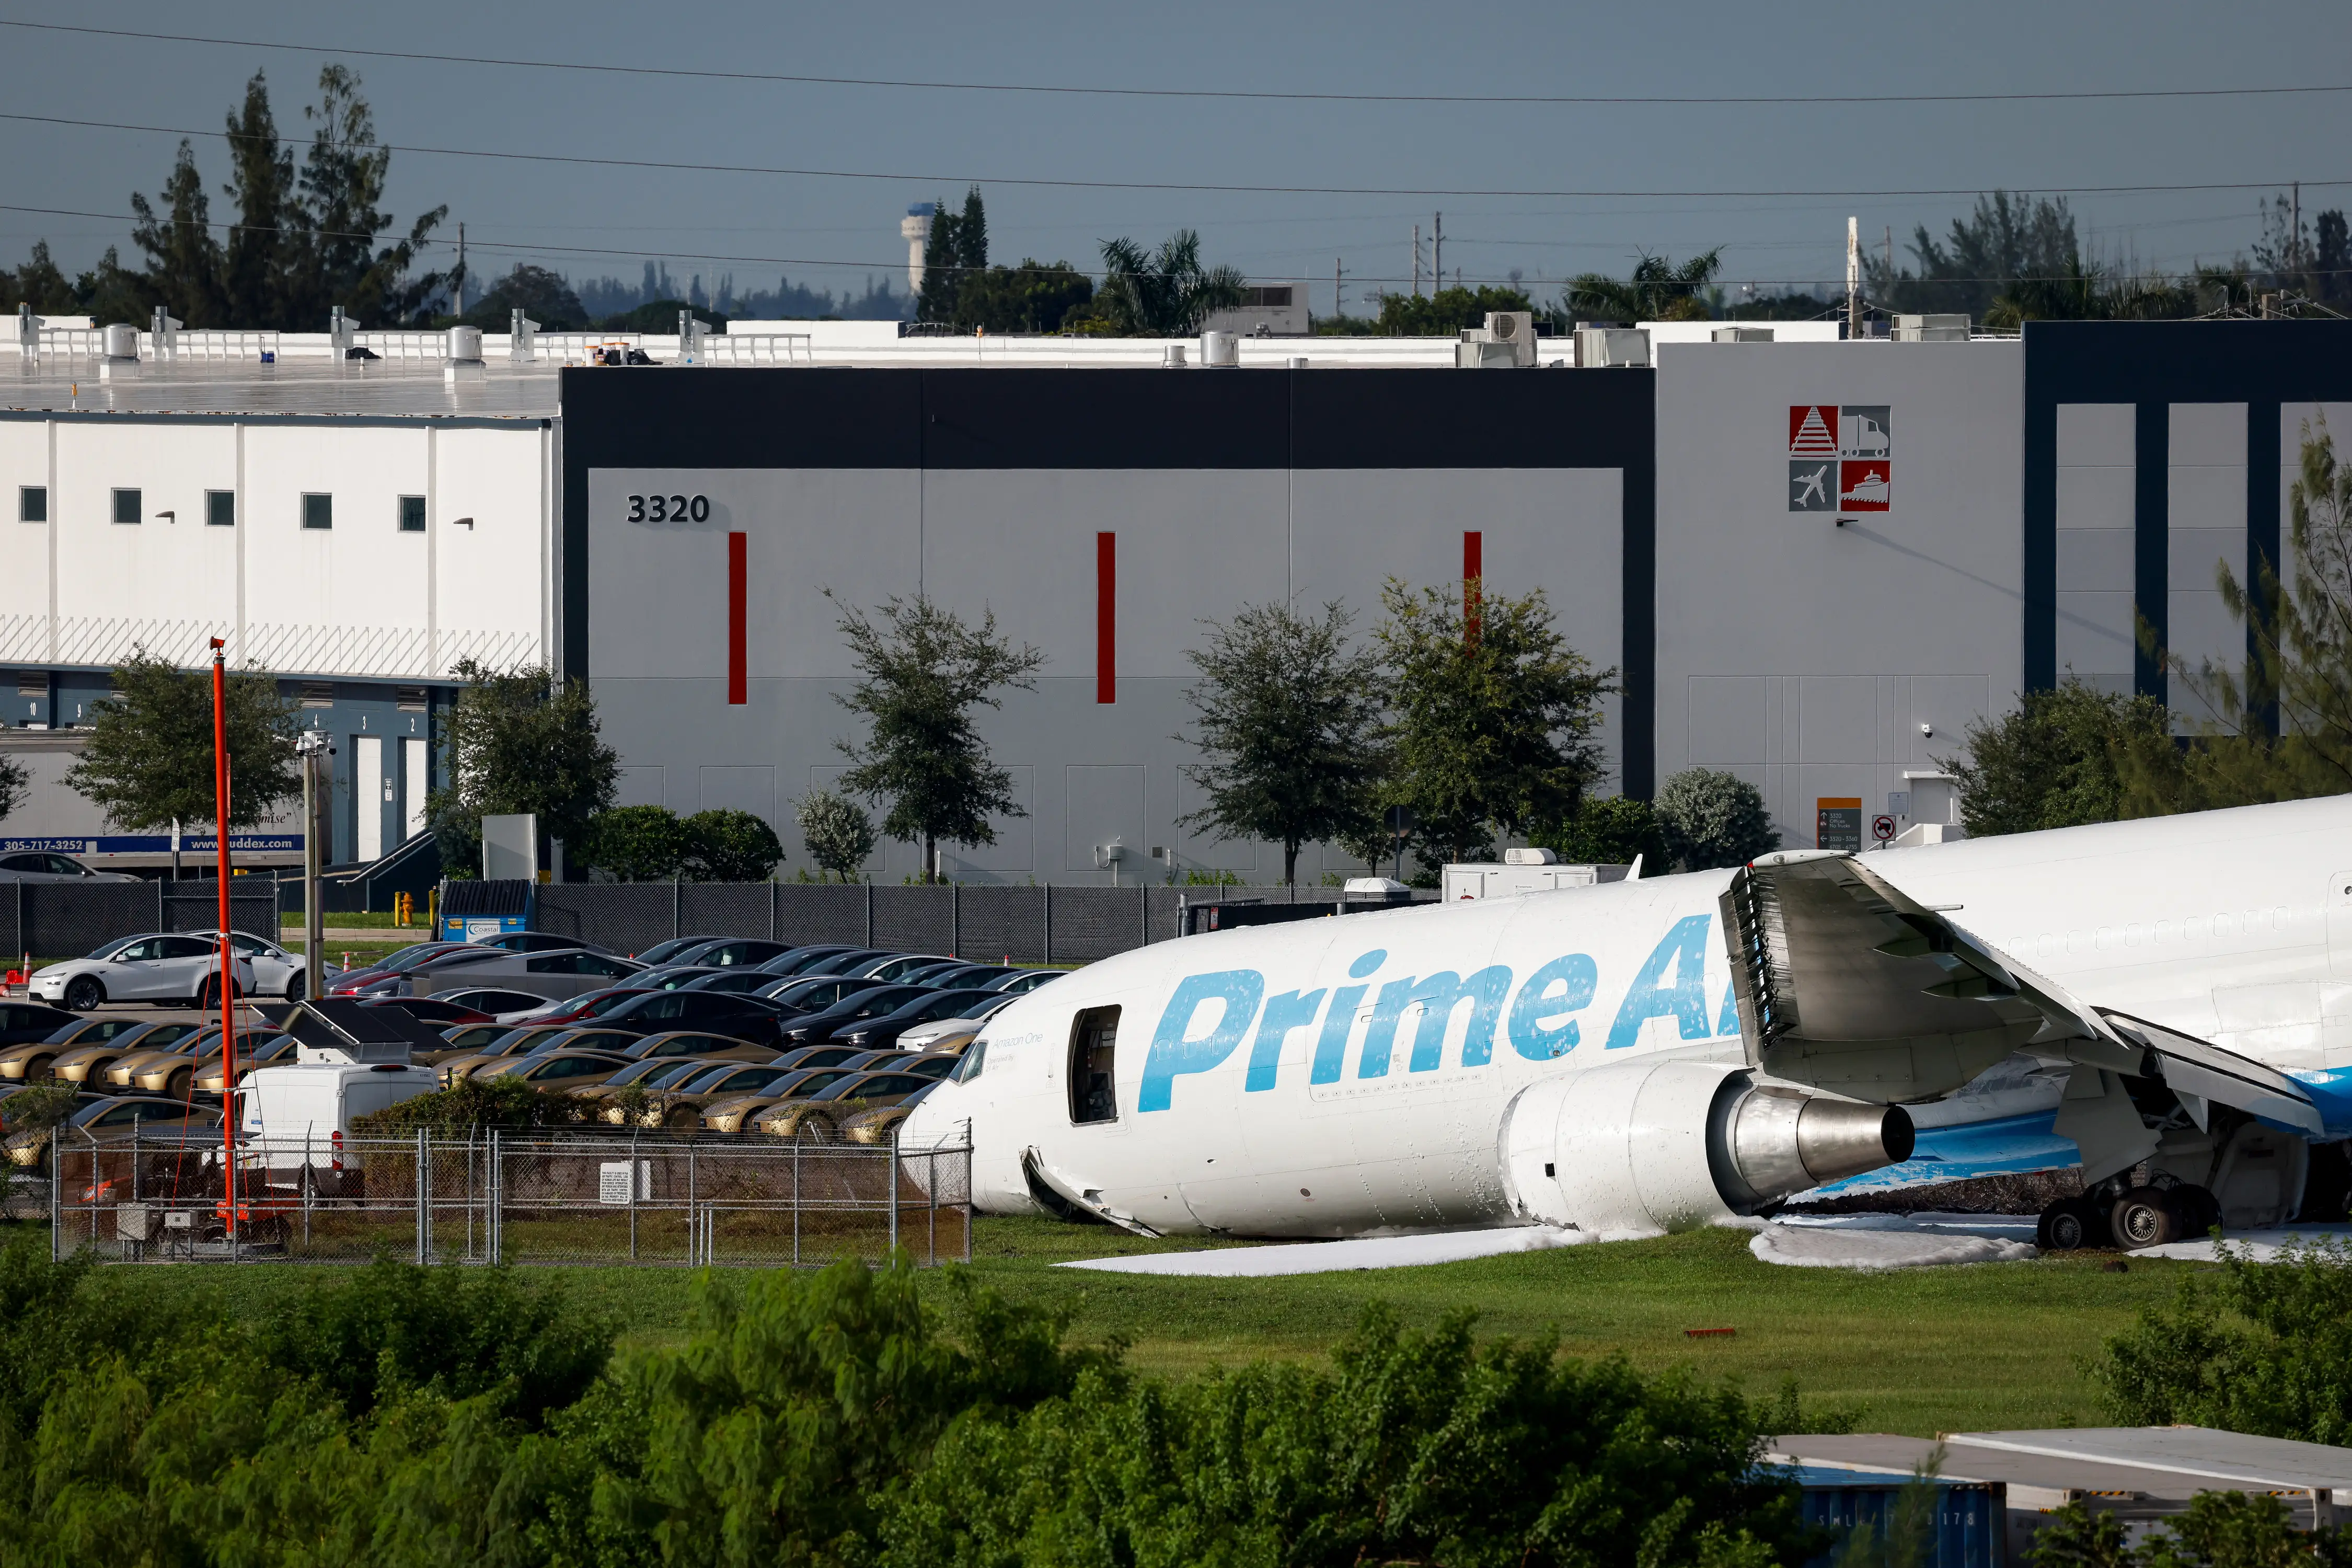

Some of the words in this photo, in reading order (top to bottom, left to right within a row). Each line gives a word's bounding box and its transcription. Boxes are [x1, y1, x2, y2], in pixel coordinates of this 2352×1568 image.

[627, 494, 709, 523] 3320
[30, 702, 36, 716] 10
[78, 704, 81, 718] 9
[314, 714, 318, 728] 4
[363, 716, 366, 730] 3
[411, 718, 414, 732] 2
[4, 840, 83, 850] 305-717-3252
[191, 837, 292, 848] wwwuddex.com
[1137, 949, 1598, 1113] Prime
[993, 1036, 1023, 1050] Amazon
[1025, 1032, 1043, 1044] One
[987, 1055, 1008, 1065] Operated
